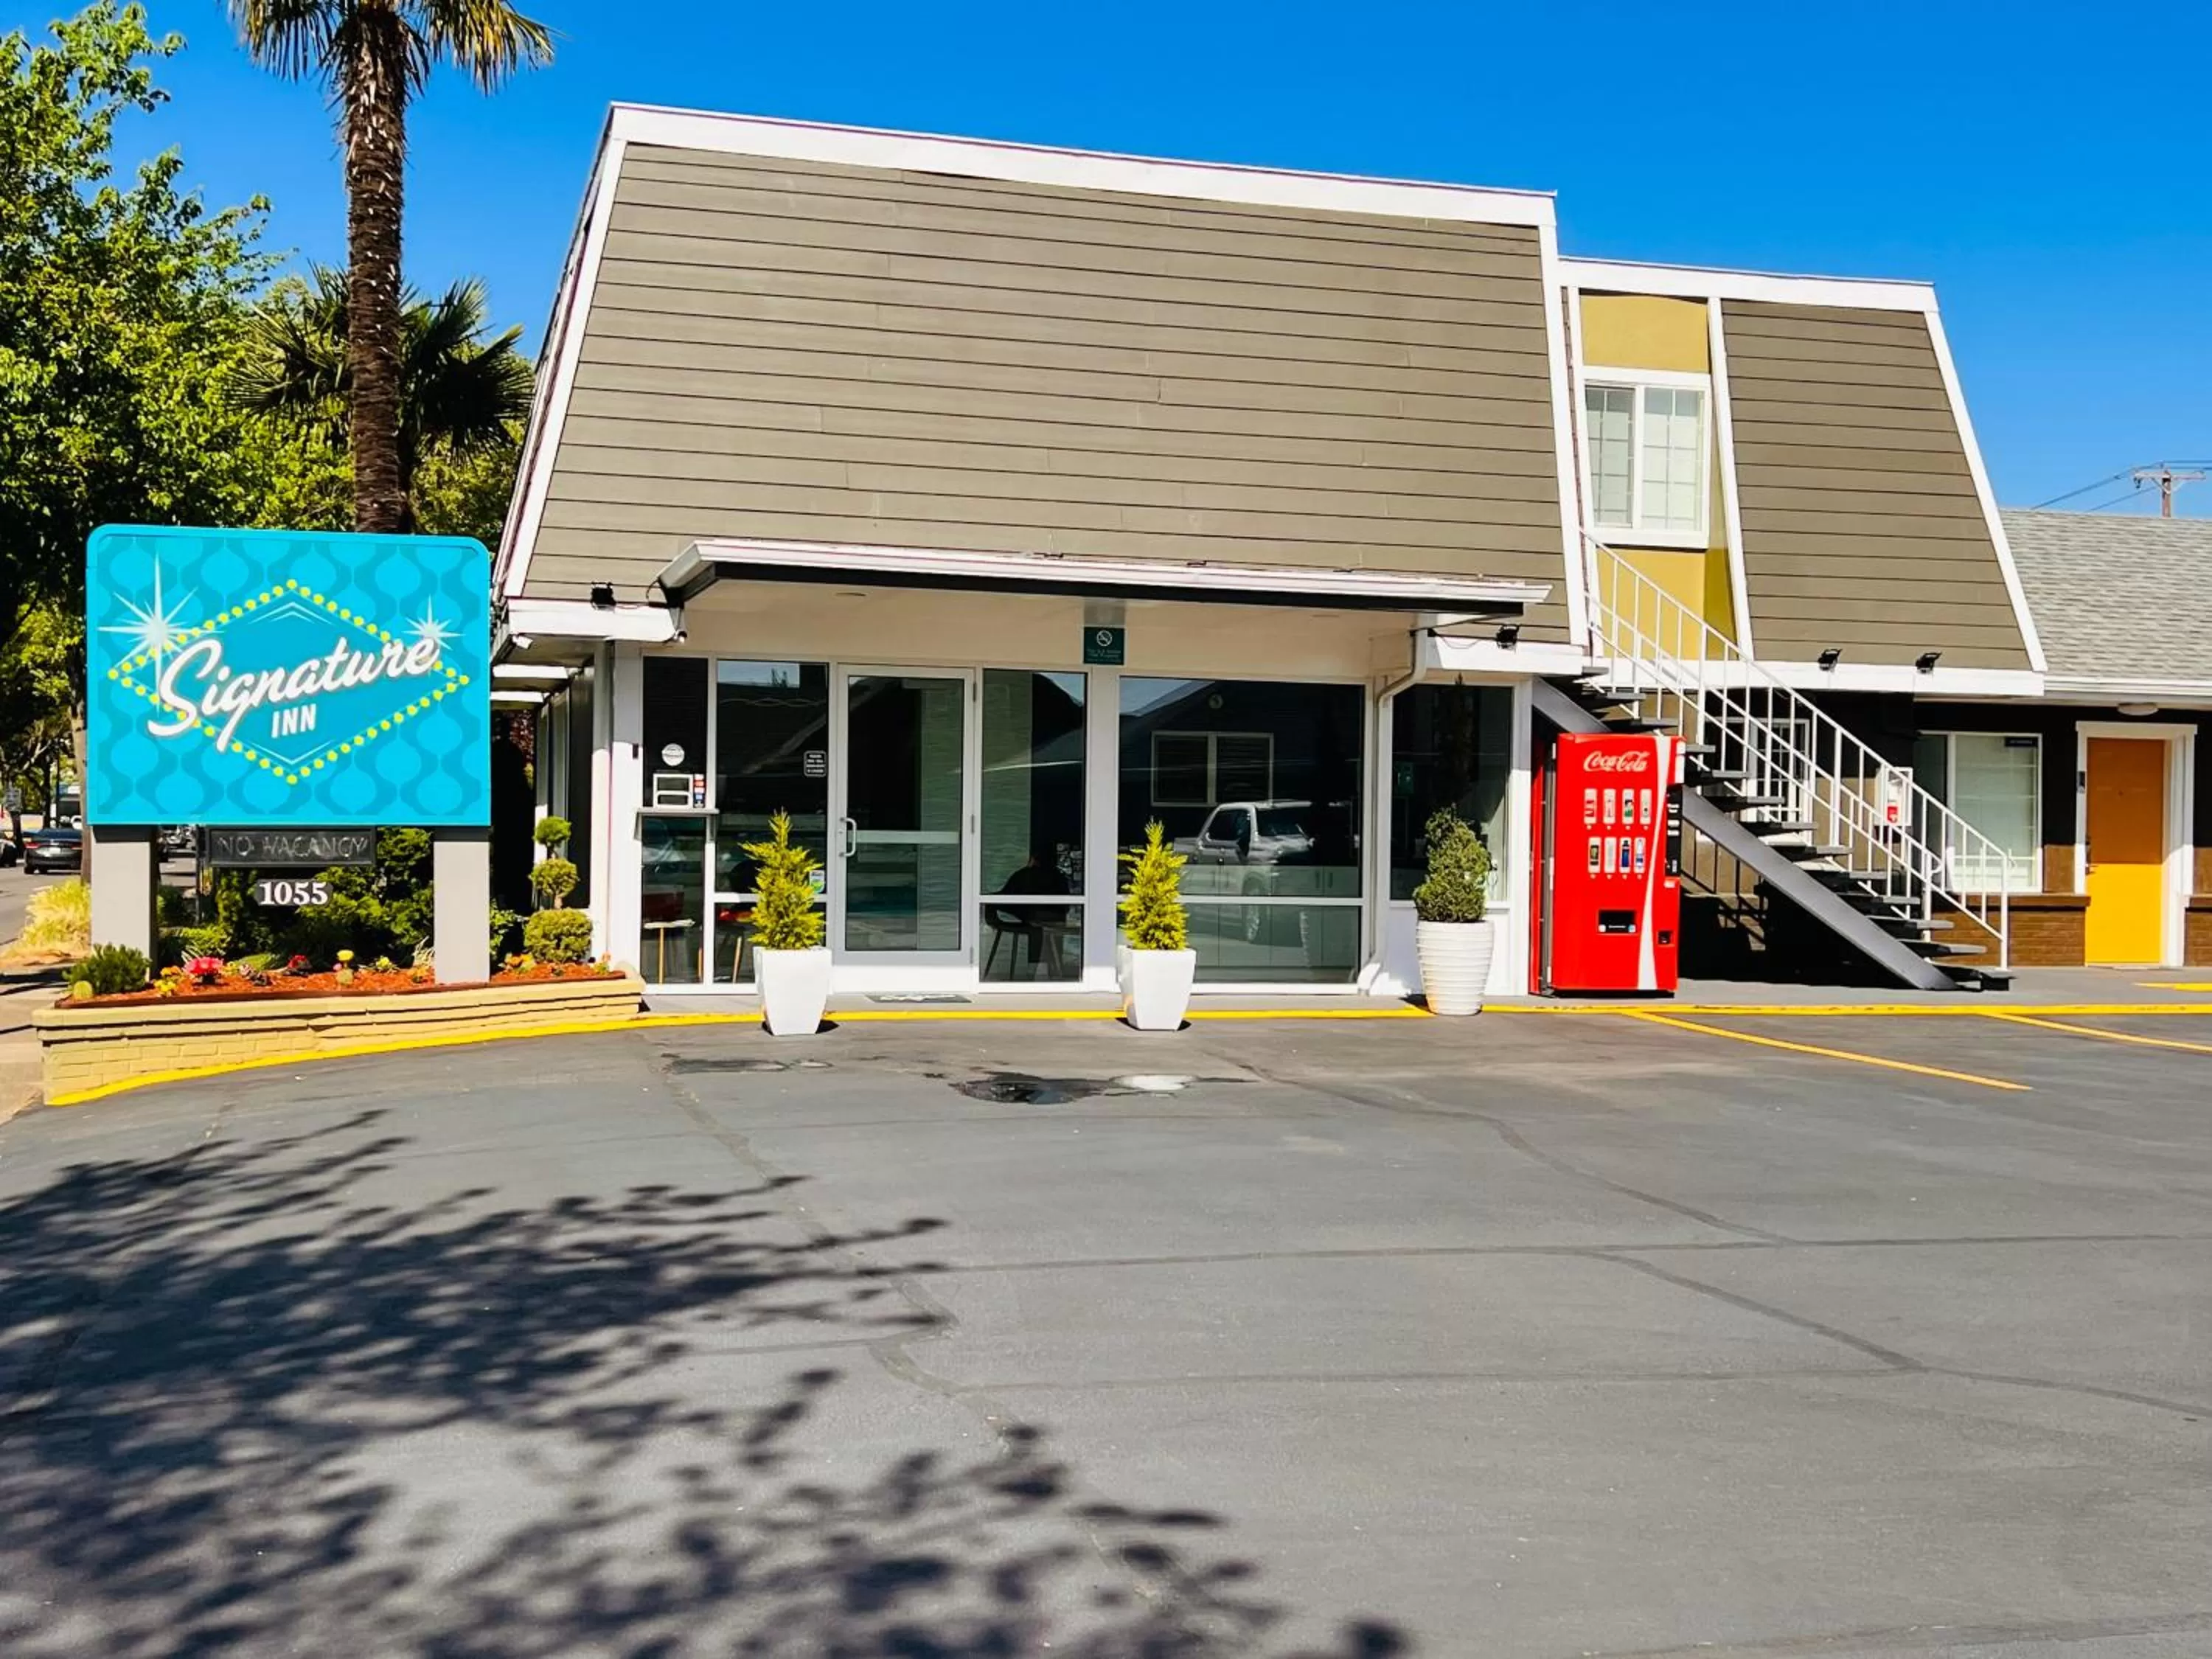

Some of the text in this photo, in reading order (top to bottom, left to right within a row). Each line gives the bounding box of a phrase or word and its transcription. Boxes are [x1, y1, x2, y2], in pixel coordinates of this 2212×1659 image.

[147, 636, 440, 752] Signature
[271, 703, 317, 738] INN
[218, 836, 368, 857] NO VACANCY
[259, 881, 328, 905] 1055
